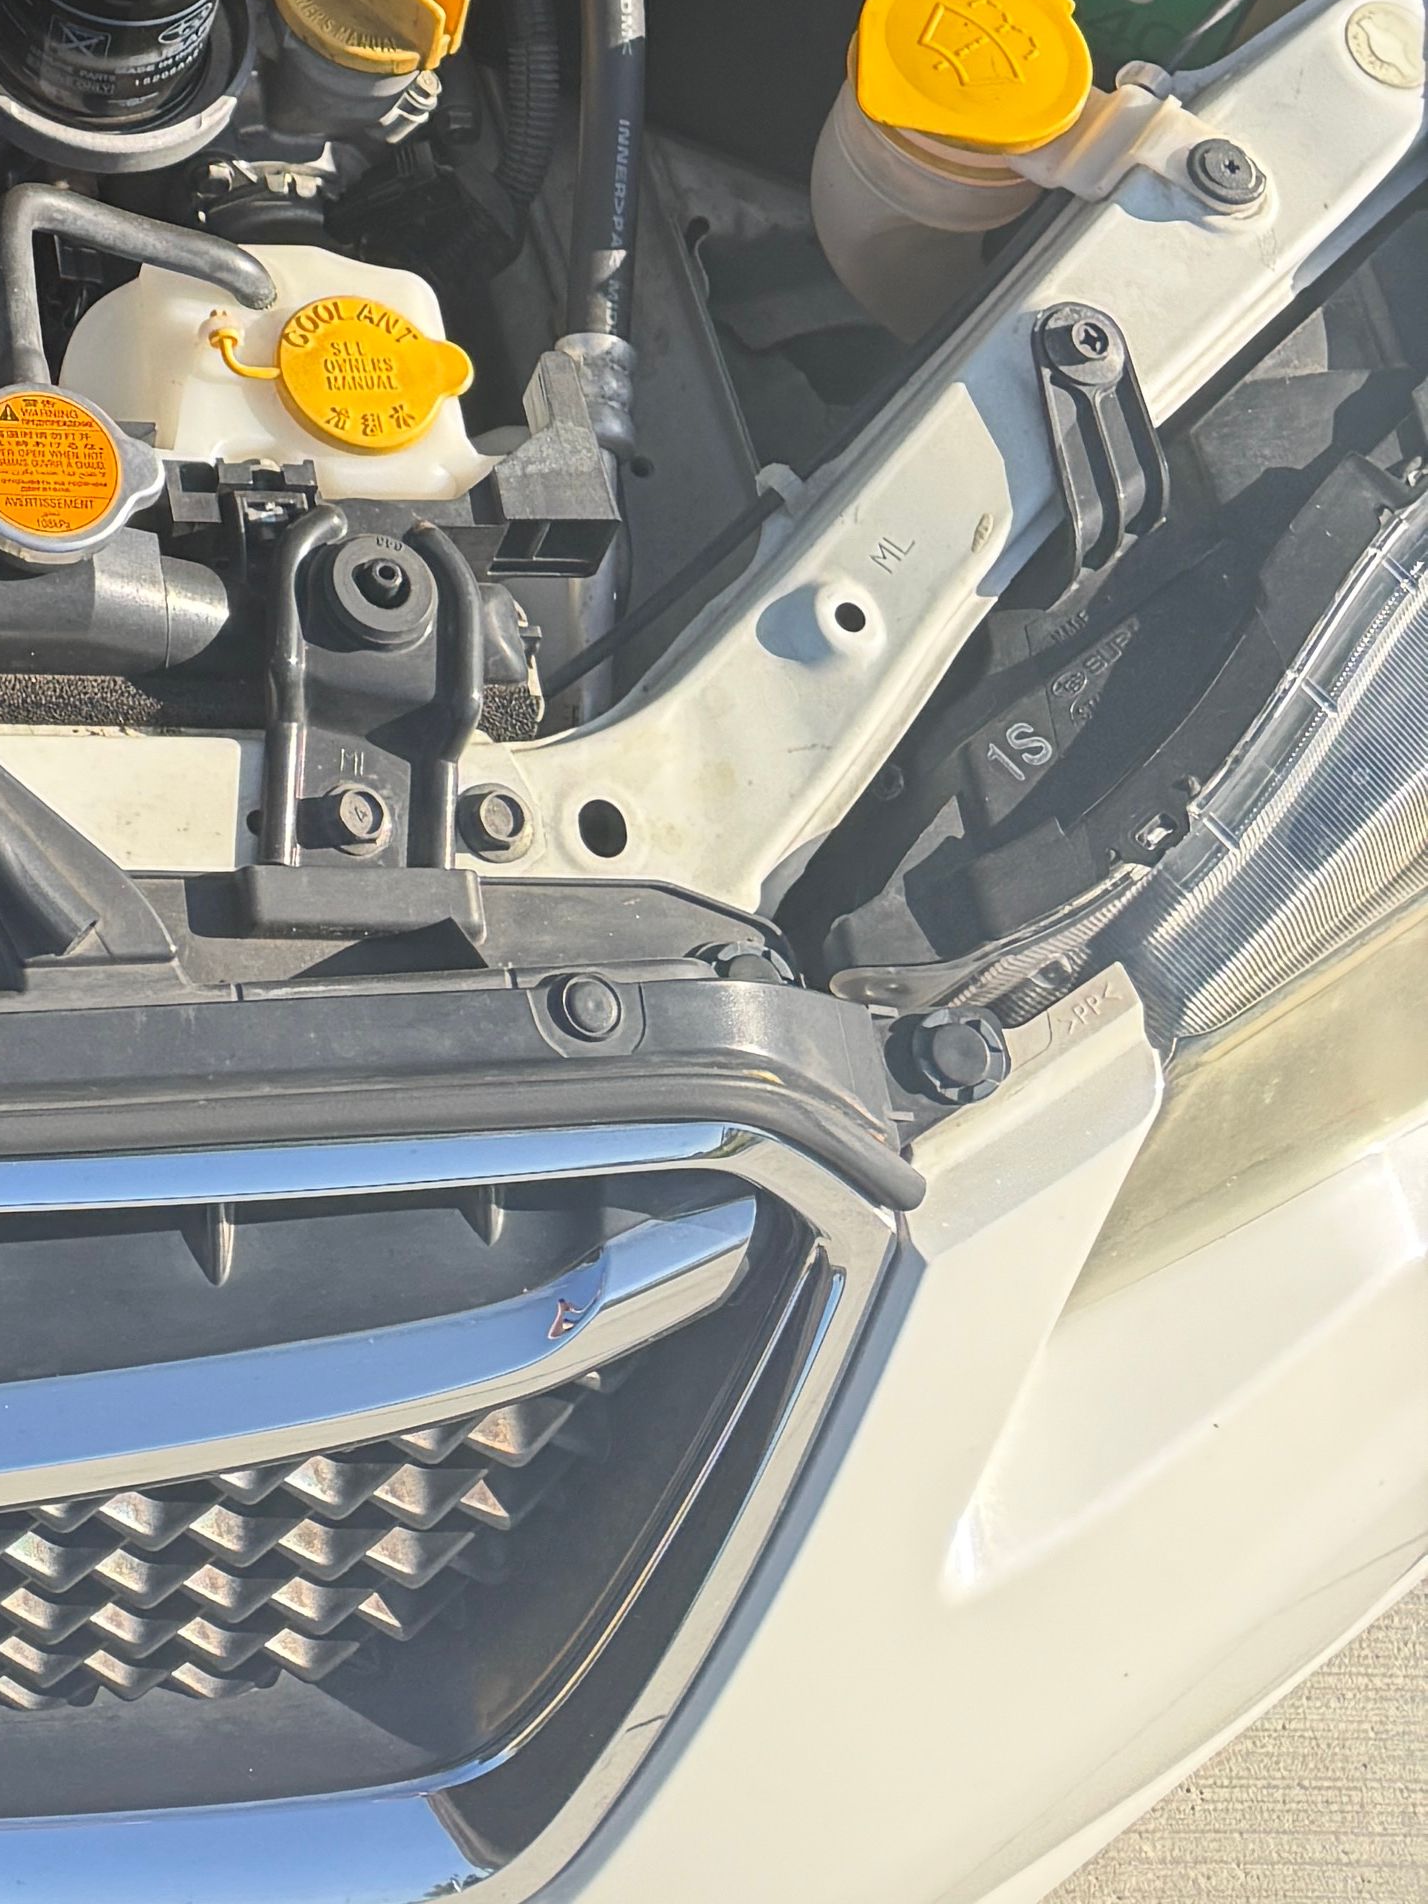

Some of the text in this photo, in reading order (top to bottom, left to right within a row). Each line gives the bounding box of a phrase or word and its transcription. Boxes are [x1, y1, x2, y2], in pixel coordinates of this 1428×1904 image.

[282, 301, 419, 349] COOLANT
[21, 408, 79, 420] WARNING
[18, 449, 45, 460] OPEN
[49, 449, 80, 461] WHEN
[5, 496, 94, 510] AVERTISSEMENT
[869, 534, 917, 576] ML
[985, 721, 1054, 782] 1S
